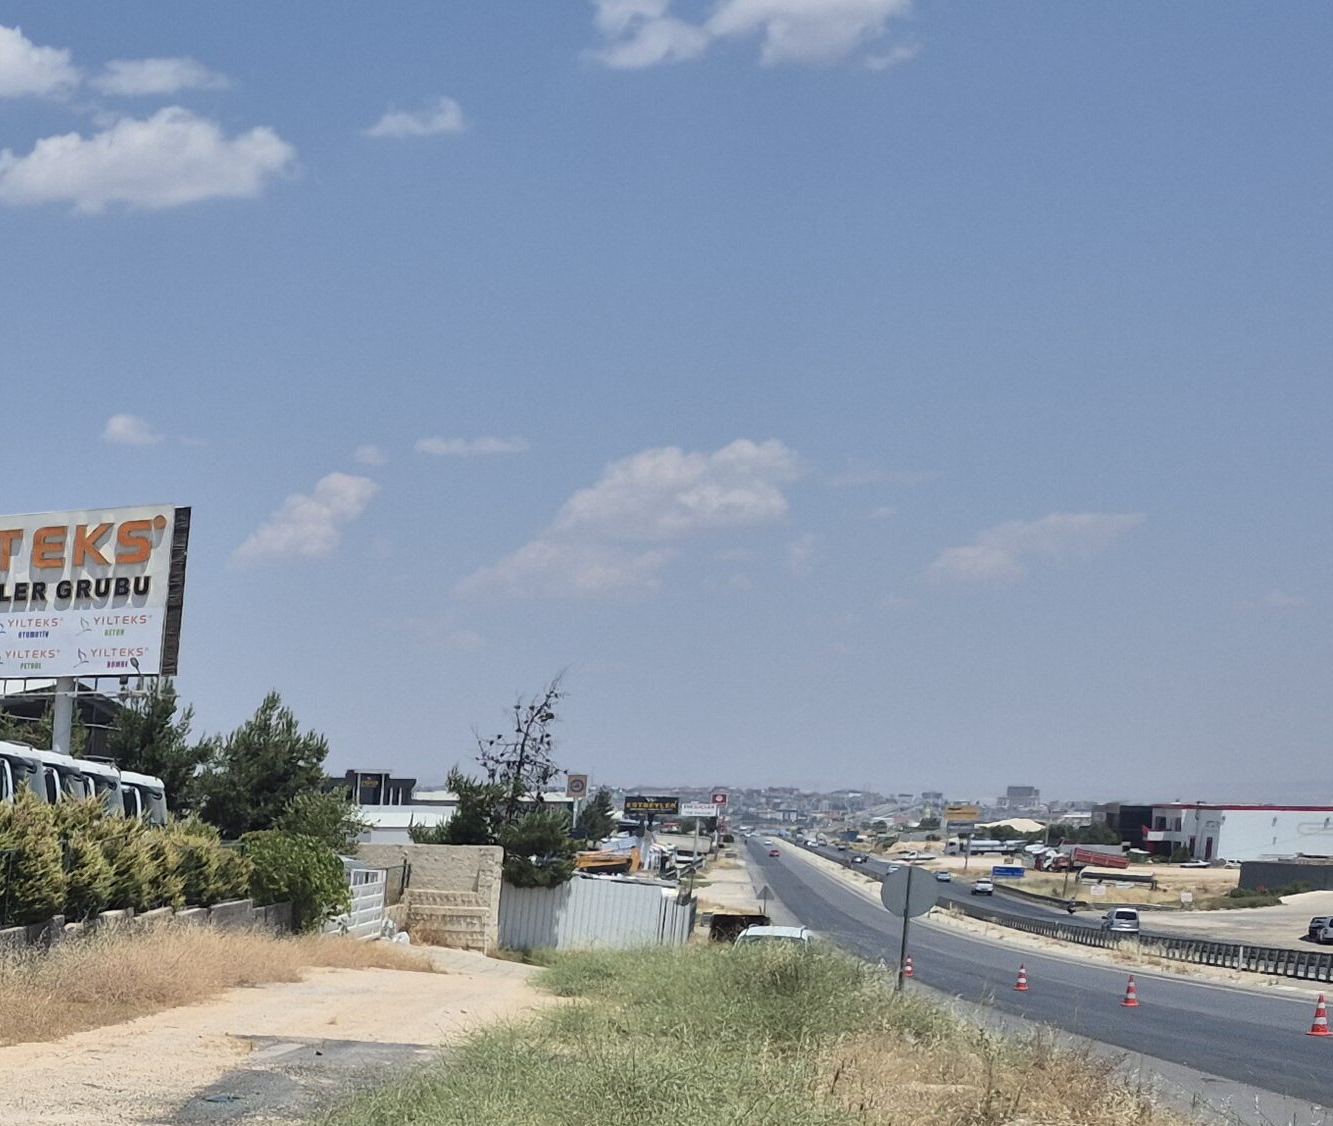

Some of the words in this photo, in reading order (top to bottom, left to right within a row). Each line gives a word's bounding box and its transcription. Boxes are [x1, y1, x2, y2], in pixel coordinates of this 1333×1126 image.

[55, 576, 151, 599] GRUBU
[8, 617, 59, 628] YILTEKS
[94, 614, 147, 626] YILTEKS
[5, 649, 56, 659] YILTEKS
[91, 647, 144, 657] YILTEKS
